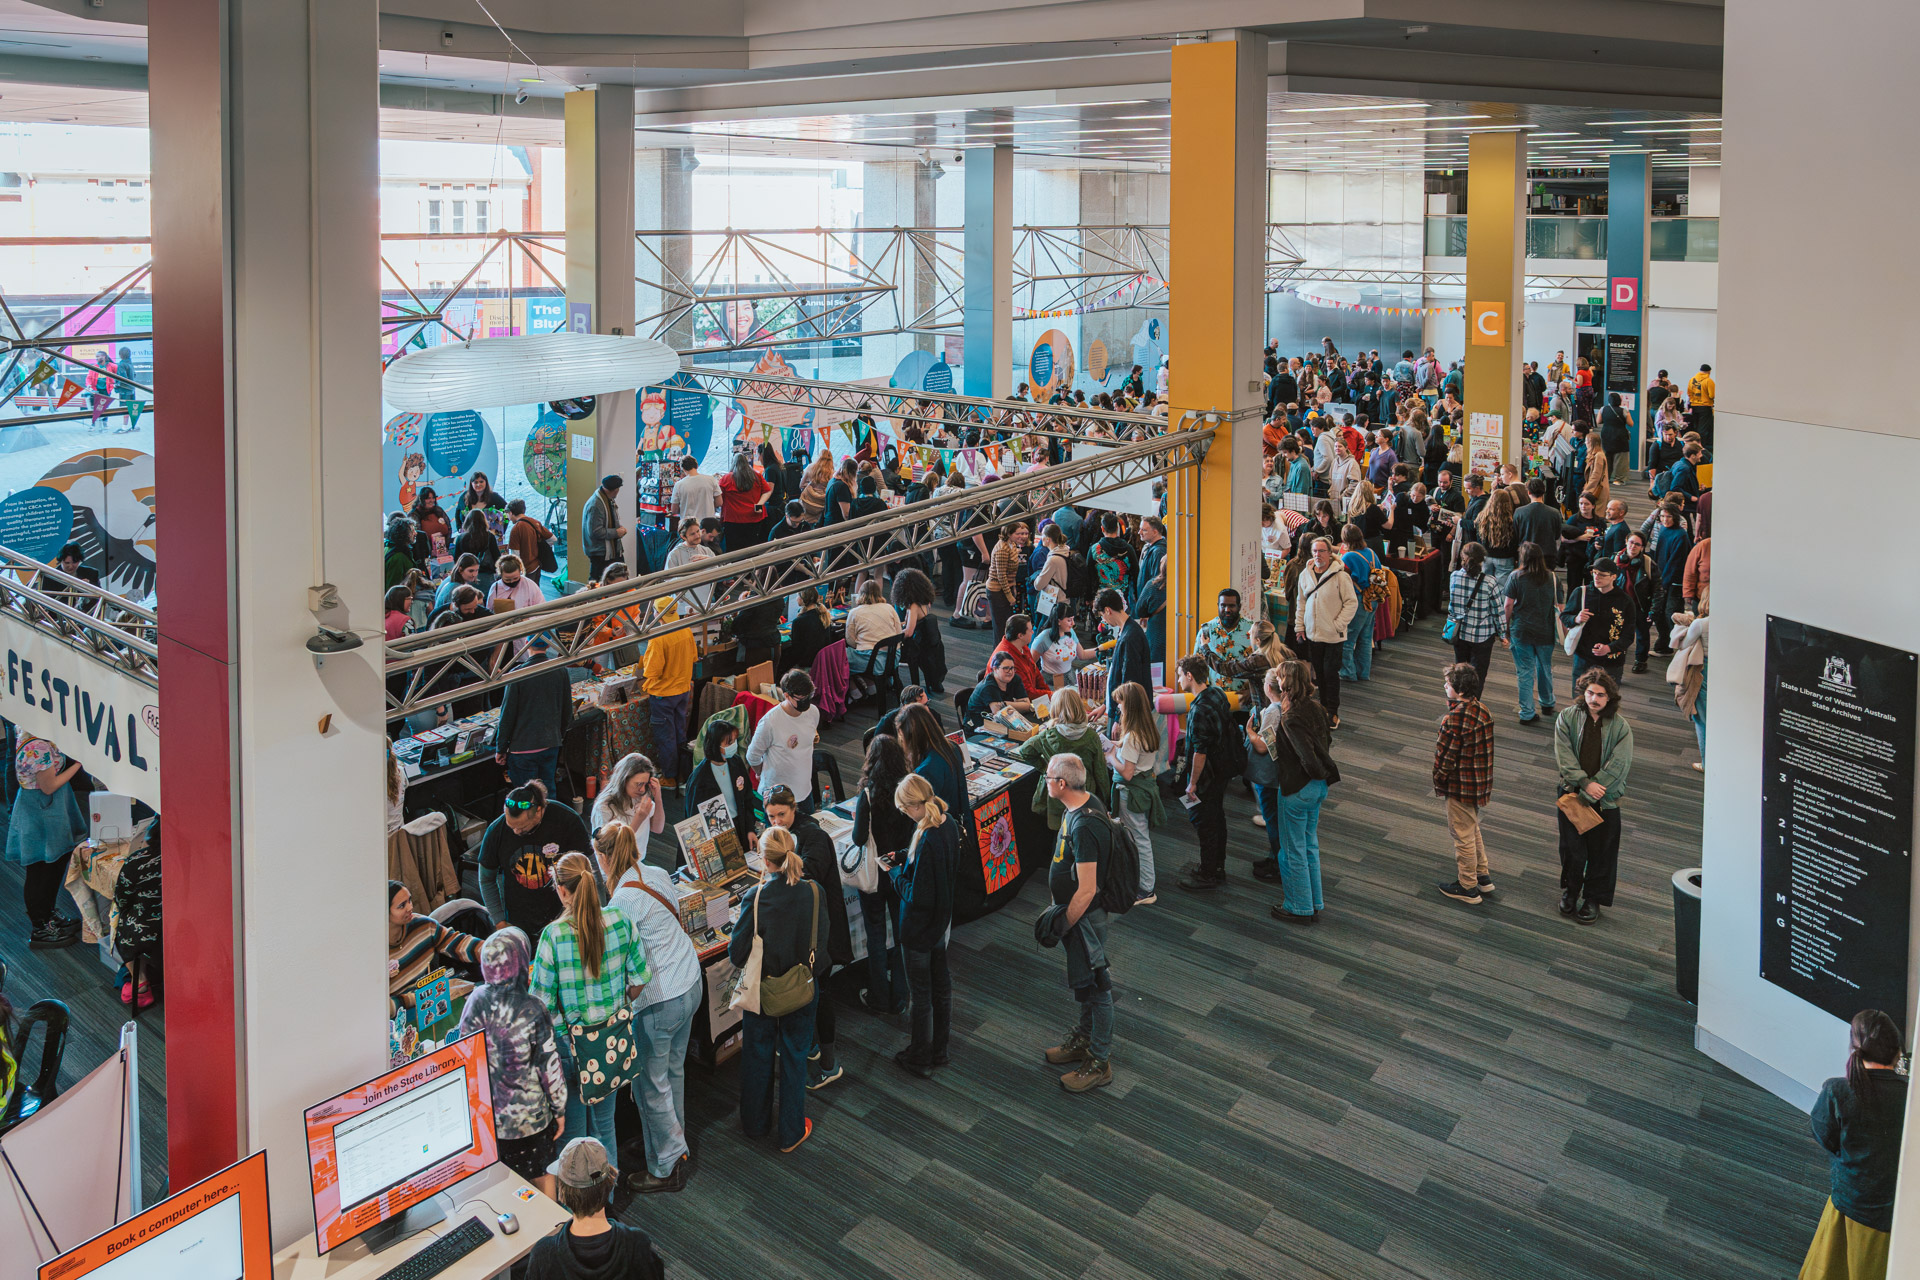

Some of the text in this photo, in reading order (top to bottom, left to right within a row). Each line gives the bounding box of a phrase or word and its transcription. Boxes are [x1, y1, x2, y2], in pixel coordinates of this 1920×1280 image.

[1616, 284, 1634, 302] D
[533, 304, 562, 315] The
[1478, 312, 1498, 336] C
[1781, 682, 1798, 691] State
[1800, 688, 1823, 700] Library
[1834, 698, 1862, 712] Western
[1864, 708, 1896, 722] Australia
[1836, 690, 1856, 698] AUSTRALIA
[8, 649, 148, 772] FESTIVAL
[1812, 701, 1861, 721] State Archives
[147, 710, 160, 732] FRE
[1780, 773, 1786, 782] 3
[1806, 790, 1825, 800] Archives
[1793, 800, 1808, 808] Family
[1809, 805, 1825, 815] History
[1818, 787, 1834, 797] Library
[1854, 801, 1877, 812] Australian
[1878, 810, 1896, 820] History
[1778, 818, 1785, 828] 2
[1832, 807, 1851, 818] Reading
[1852, 814, 1866, 823] Room
[1779, 836, 1784, 844] 1
[1793, 831, 1810, 841] General
[1810, 838, 1833, 850] Reference
[1805, 818, 1827, 830] Executive
[1828, 827, 1844, 836] Officer
[1868, 843, 1889, 854] Librarian
[1792, 856, 1856, 885] General Reference Collection
[1792, 869, 1818, 884] Newspapers
[1840, 869, 1860, 880] Australia
[1844, 863, 1868, 875] Collection
[1831, 879, 1845, 888] Space
[1777, 893, 1785, 904] M
[1826, 891, 1842, 901] Awards
[1792, 900, 1813, 913] Education
[1820, 903, 1832, 911] space
[1843, 914, 1864, 925] materials
[1777, 918, 1785, 927] G
[1801, 911, 1812, 920] Story
[1791, 924, 1830, 946] Discovery Lounge
[1800, 918, 1812, 927] Story
[1826, 930, 1842, 941] Gallery
[1791, 932, 1807, 942] Ground
[1821, 946, 1836, 956] Gallery
[1791, 945, 1808, 957] Meeting
[418, 970, 444, 987] STICKERS
[1791, 952, 1802, 960] State
[1803, 958, 1818, 969] Library
[1820, 966, 1836, 977] Theatre
[1847, 980, 1860, 989] Foyer
[363, 1092, 382, 1105] Join
[384, 1084, 398, 1095] the
[401, 1073, 423, 1087] State
[108, 1234, 136, 1254] Book
[139, 1229, 145, 1237] a
[149, 1200, 201, 1232] computer
[204, 1186, 228, 1203] here
